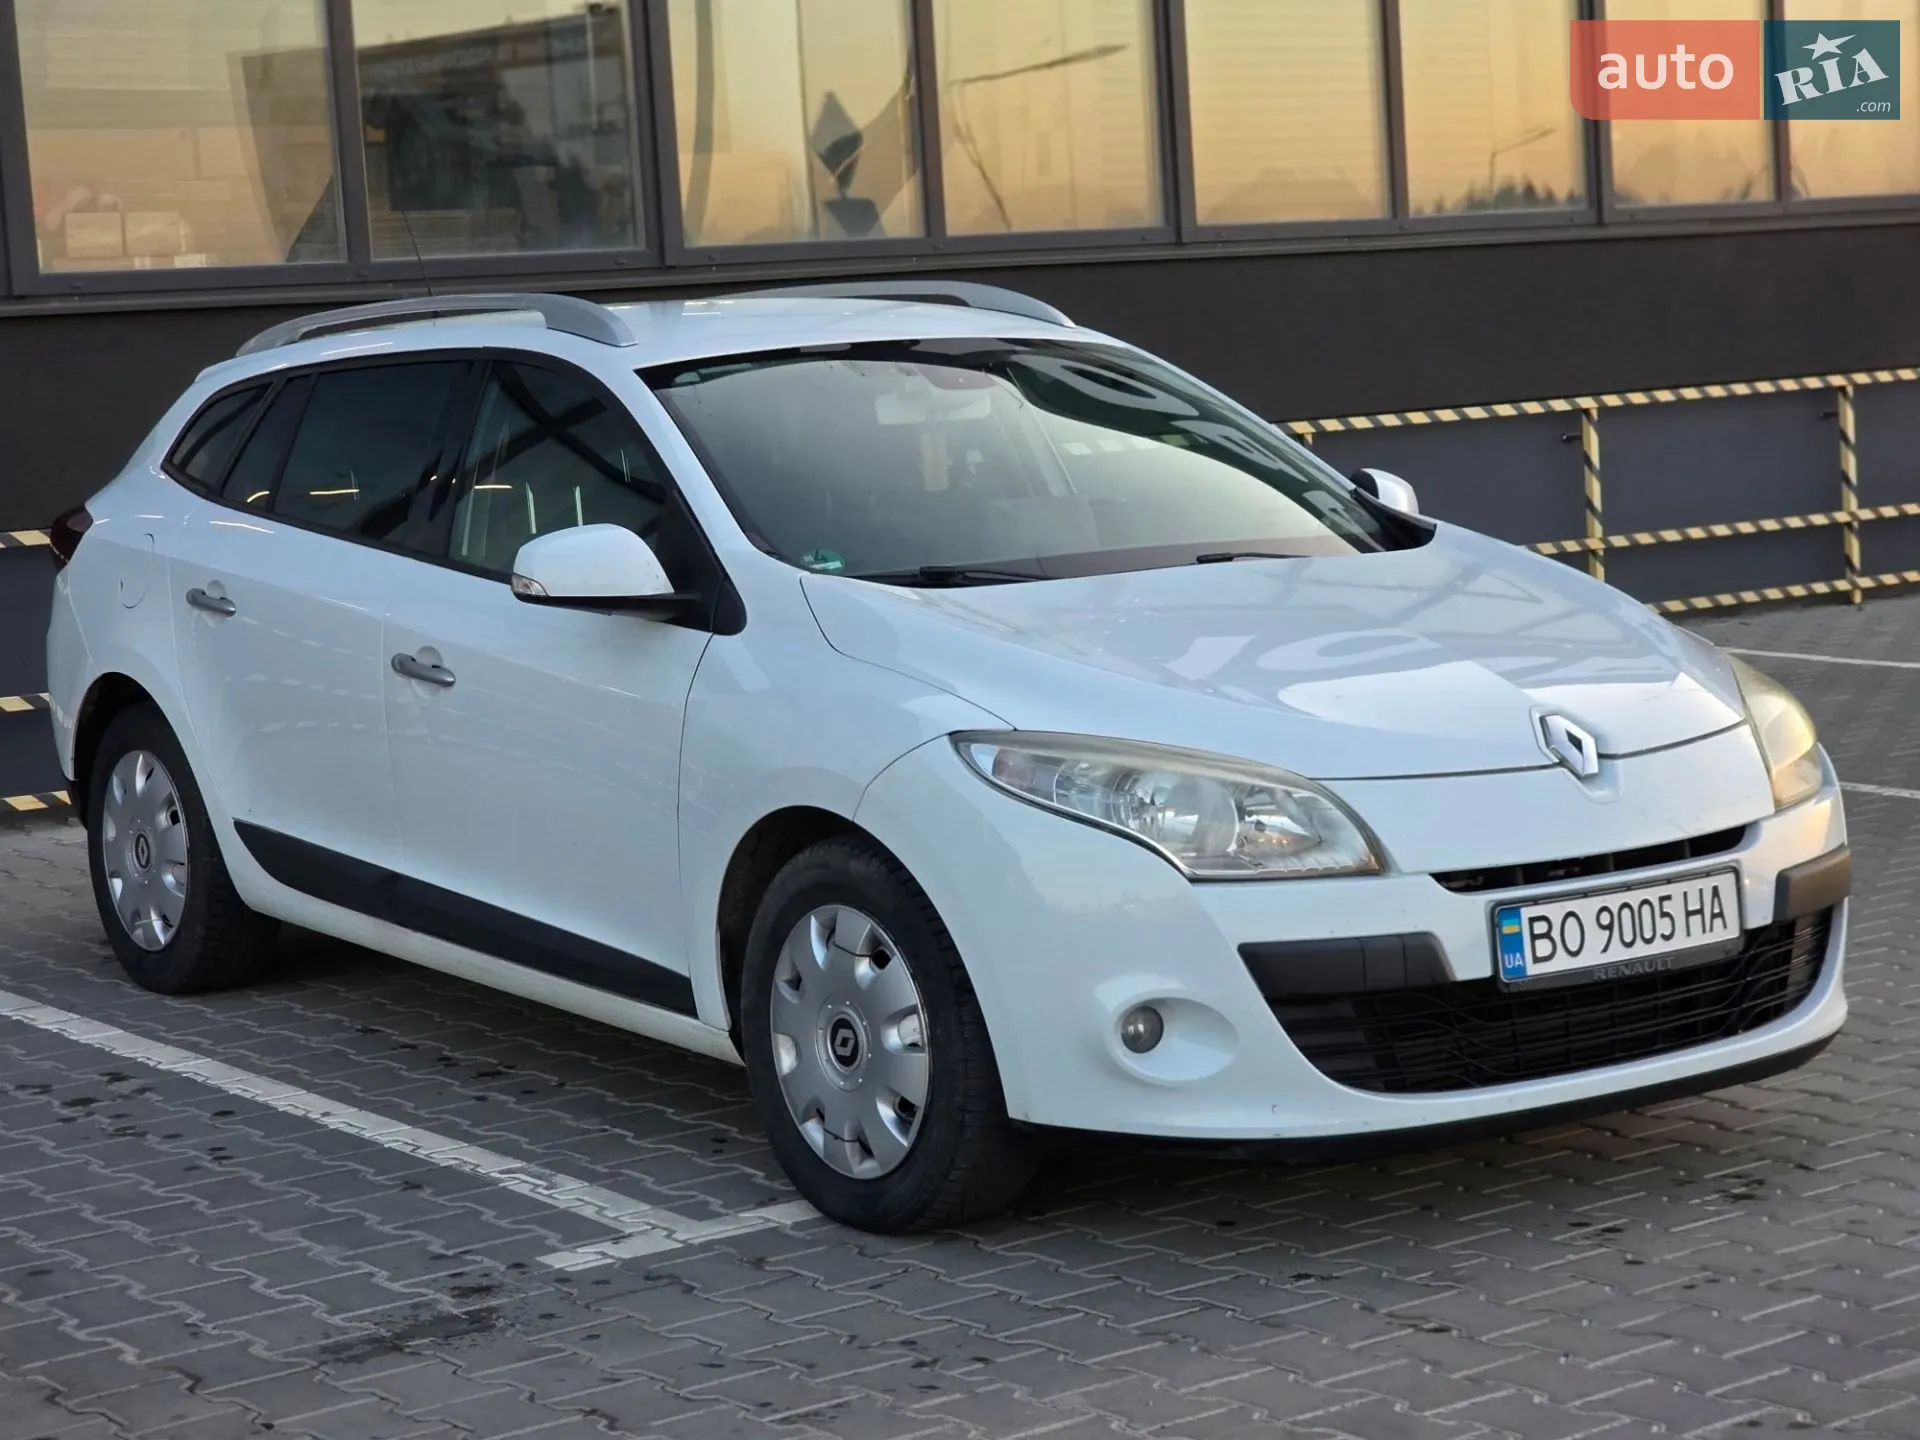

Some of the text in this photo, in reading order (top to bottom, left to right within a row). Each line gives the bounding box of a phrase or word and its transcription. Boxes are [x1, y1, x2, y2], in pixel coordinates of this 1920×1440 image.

[1528, 885, 1728, 965] BO 9005 HA
[1504, 952, 1525, 969] UA
[1593, 956, 1676, 981] RENAULT
